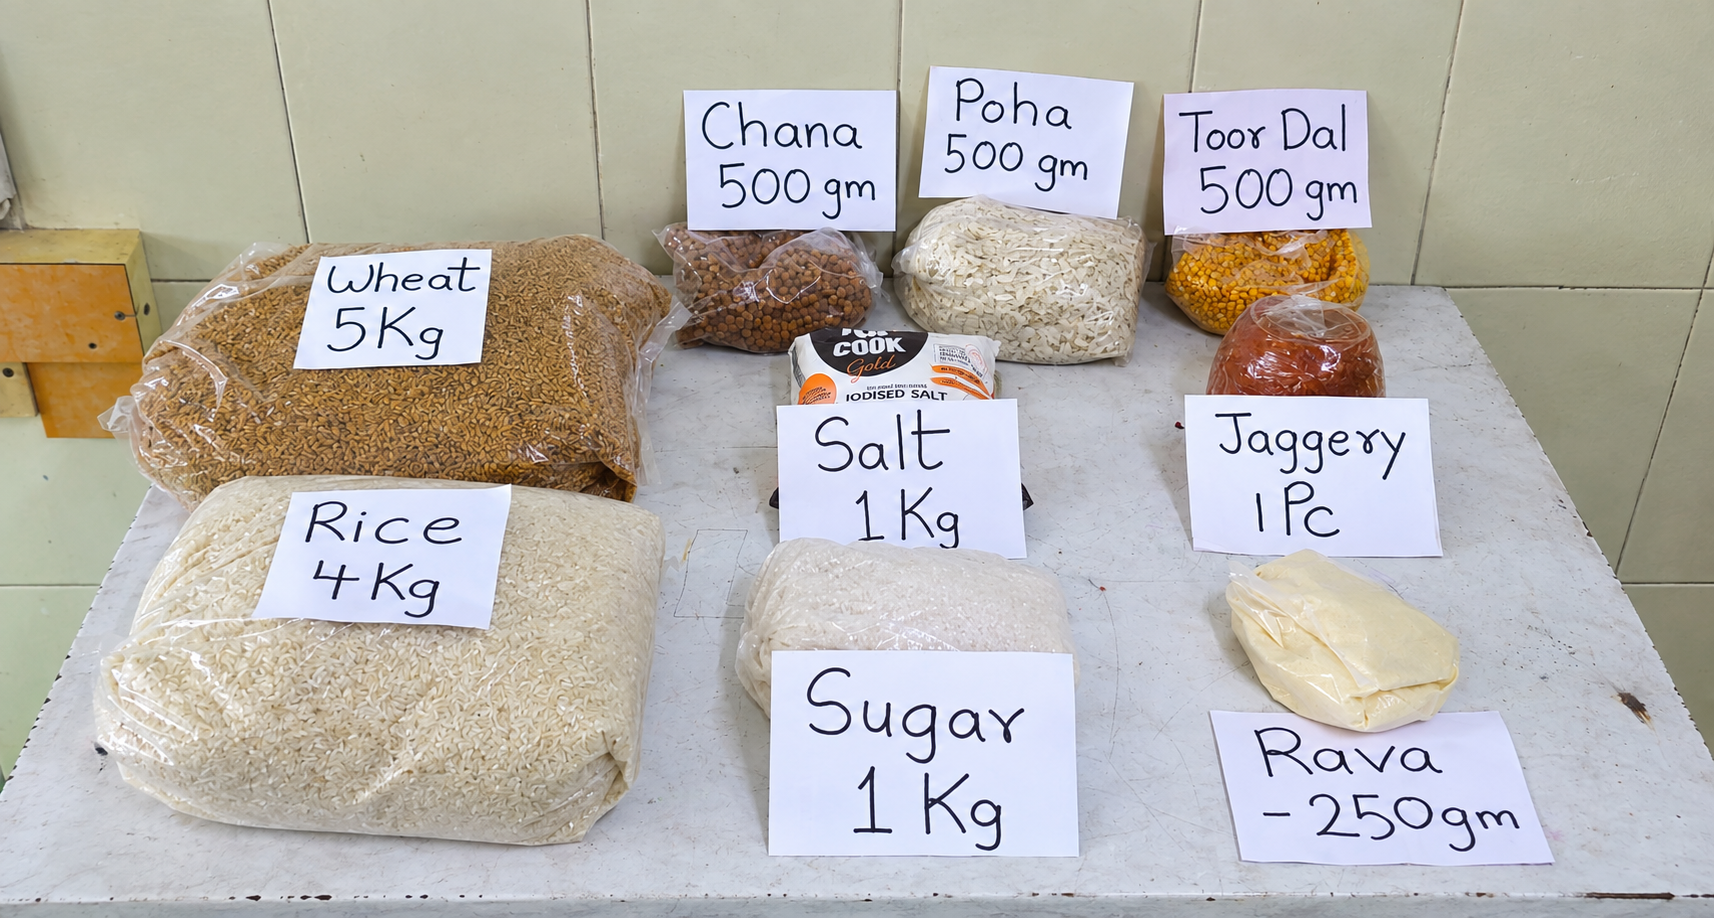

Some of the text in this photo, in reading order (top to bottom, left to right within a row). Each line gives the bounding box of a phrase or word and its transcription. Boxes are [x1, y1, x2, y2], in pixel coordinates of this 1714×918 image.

[701, 101, 864, 150] Chana
[955, 77, 1073, 130] Poha
[1178, 103, 1347, 153] Toor Dal
[944, 133, 1089, 192] 500 gm
[719, 162, 876, 220] 500 gm
[1199, 165, 1359, 221] 500 gm
[327, 256, 481, 294] Wheat
[832, 336, 907, 357] COOK
[846, 354, 897, 384] Gold
[845, 389, 906, 402] IODISED
[910, 389, 948, 401] SALT
[814, 409, 952, 472] Salt
[1215, 412, 1406, 481] Jaggery
[305, 501, 463, 545] Rice
[855, 486, 960, 549] 1 Kg
[806, 667, 1026, 764] Sugar
[1253, 727, 1443, 778] Rava
[853, 765, 1003, 851] 1 Kg
